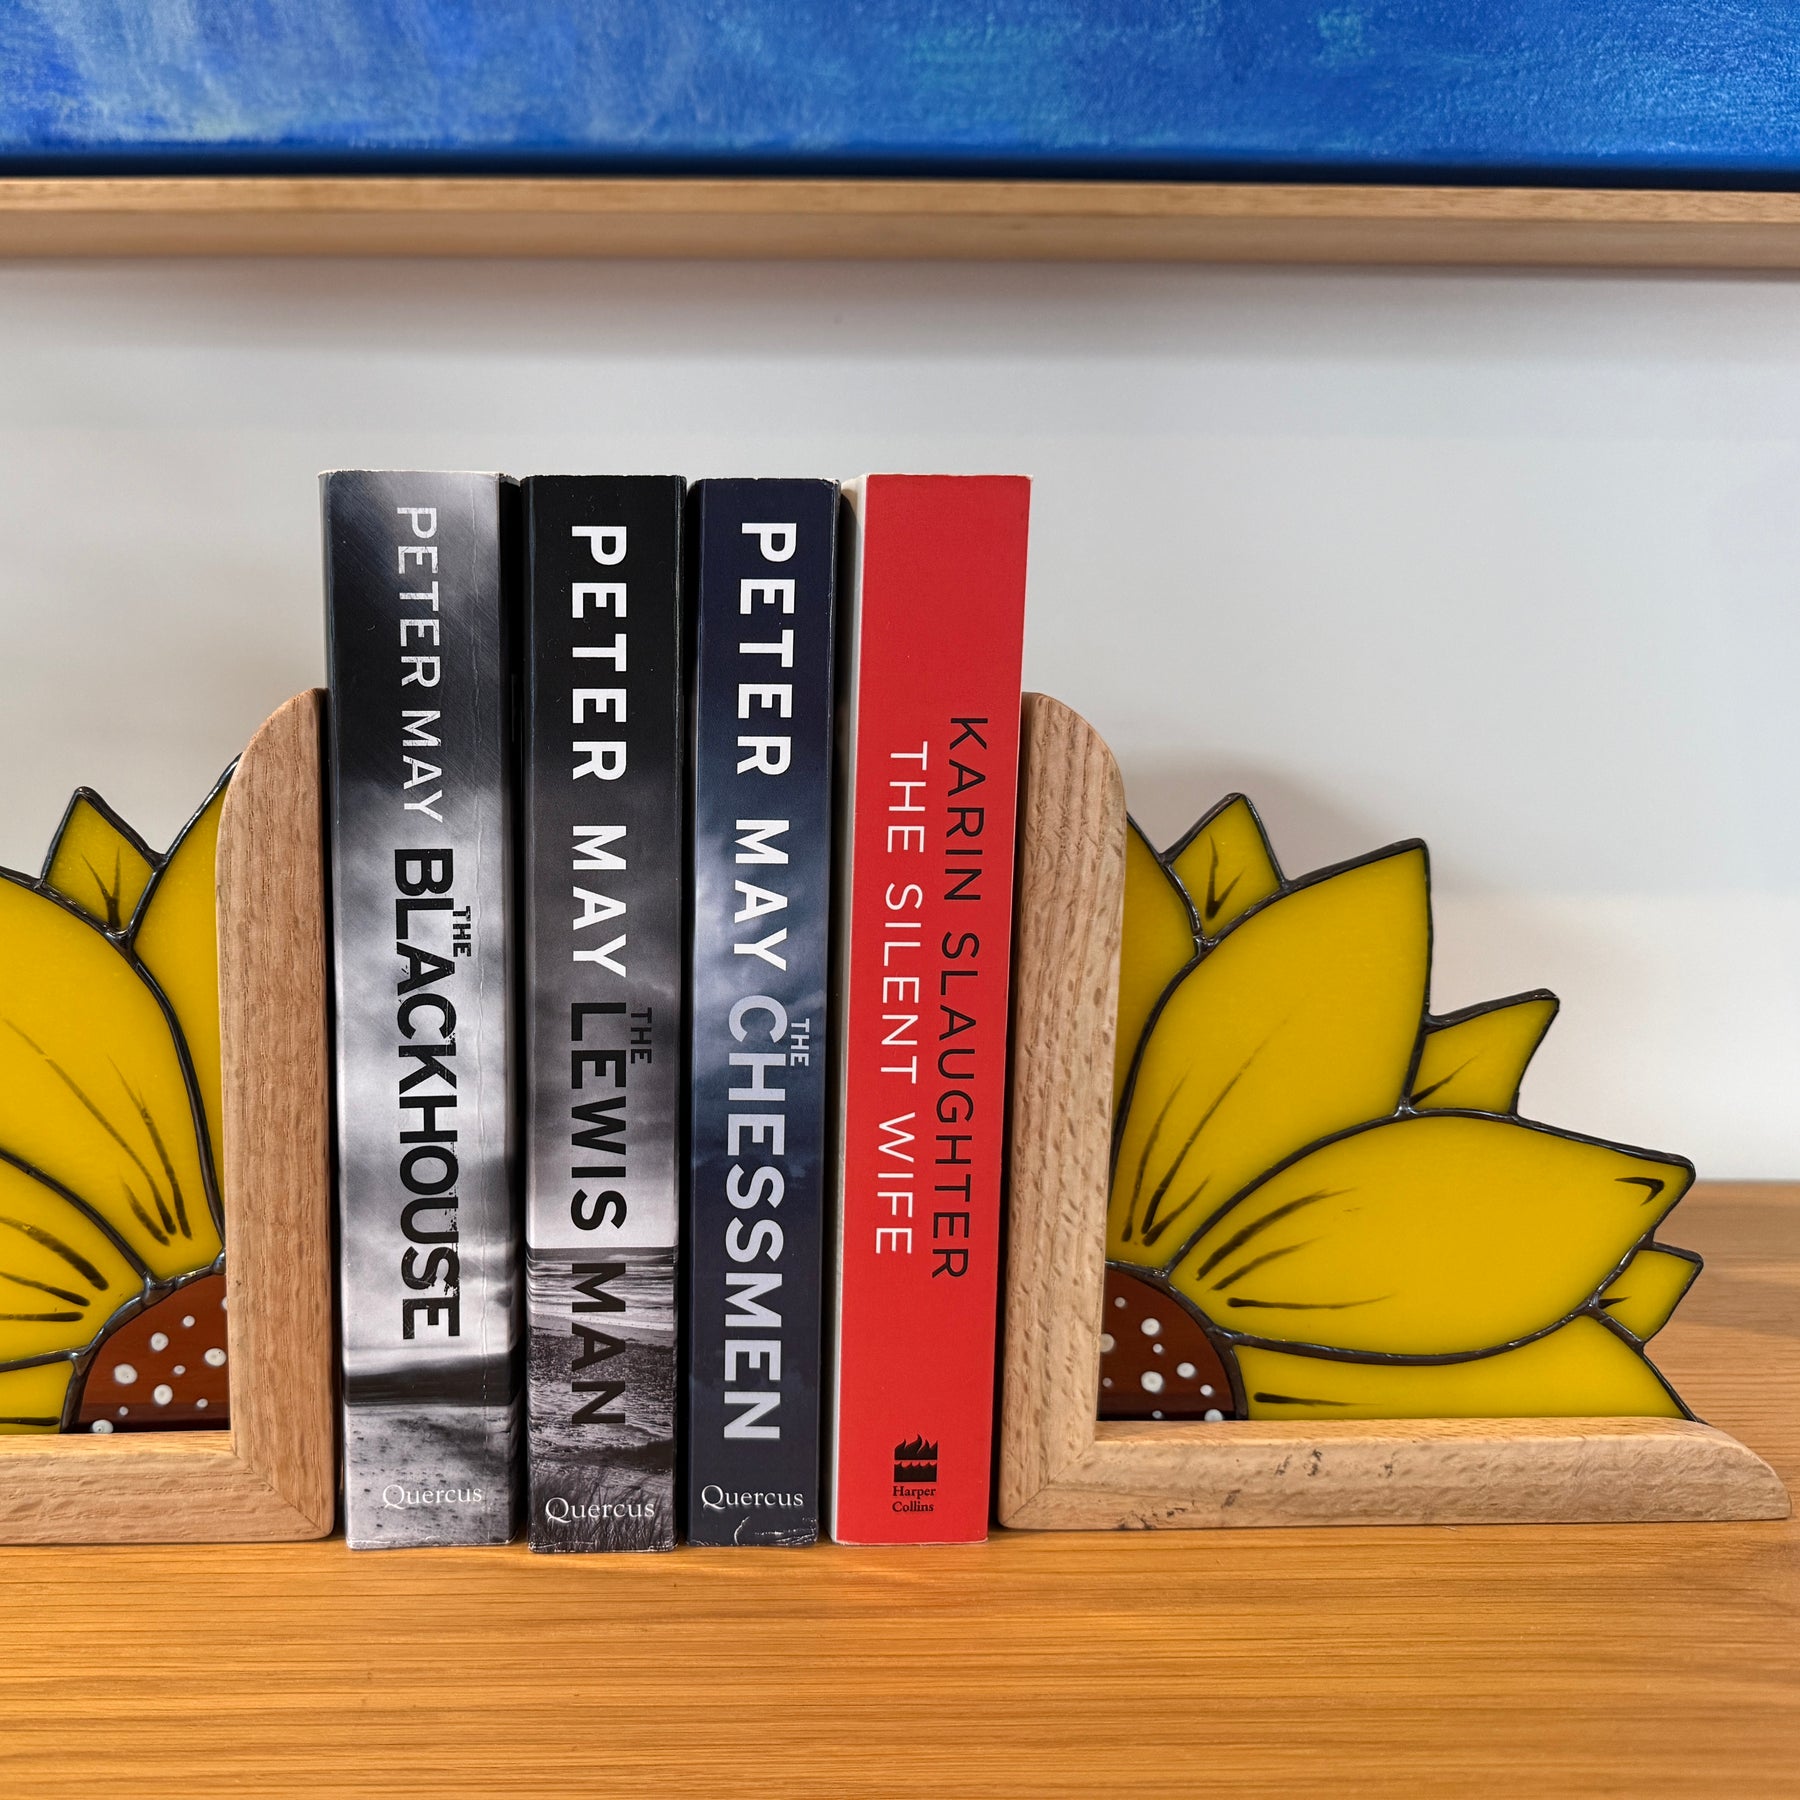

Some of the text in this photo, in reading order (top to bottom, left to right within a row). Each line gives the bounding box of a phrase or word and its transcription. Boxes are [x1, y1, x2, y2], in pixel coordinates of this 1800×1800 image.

[397, 506, 443, 823] PETER MAY
[571, 525, 627, 978] PETER MAY
[733, 522, 797, 972] PETER MAY
[452, 905, 472, 958] THE
[875, 740, 928, 1255] THE SILENT WIFE
[931, 717, 989, 1279] KARIN SLAUGHTER
[394, 848, 460, 1340] BLACKHOUSE
[630, 1007, 652, 1065] THE
[790, 1018, 810, 1067] THE
[570, 1001, 627, 1425] LEWIS MAN
[723, 994, 789, 1441] CHESSMEN
[382, 1484, 482, 1508] Quercus
[544, 1496, 655, 1524] Quercus
[700, 1484, 804, 1510] Quercus
[892, 1485, 936, 1499] Harper
[892, 1500, 934, 1512] Collins
